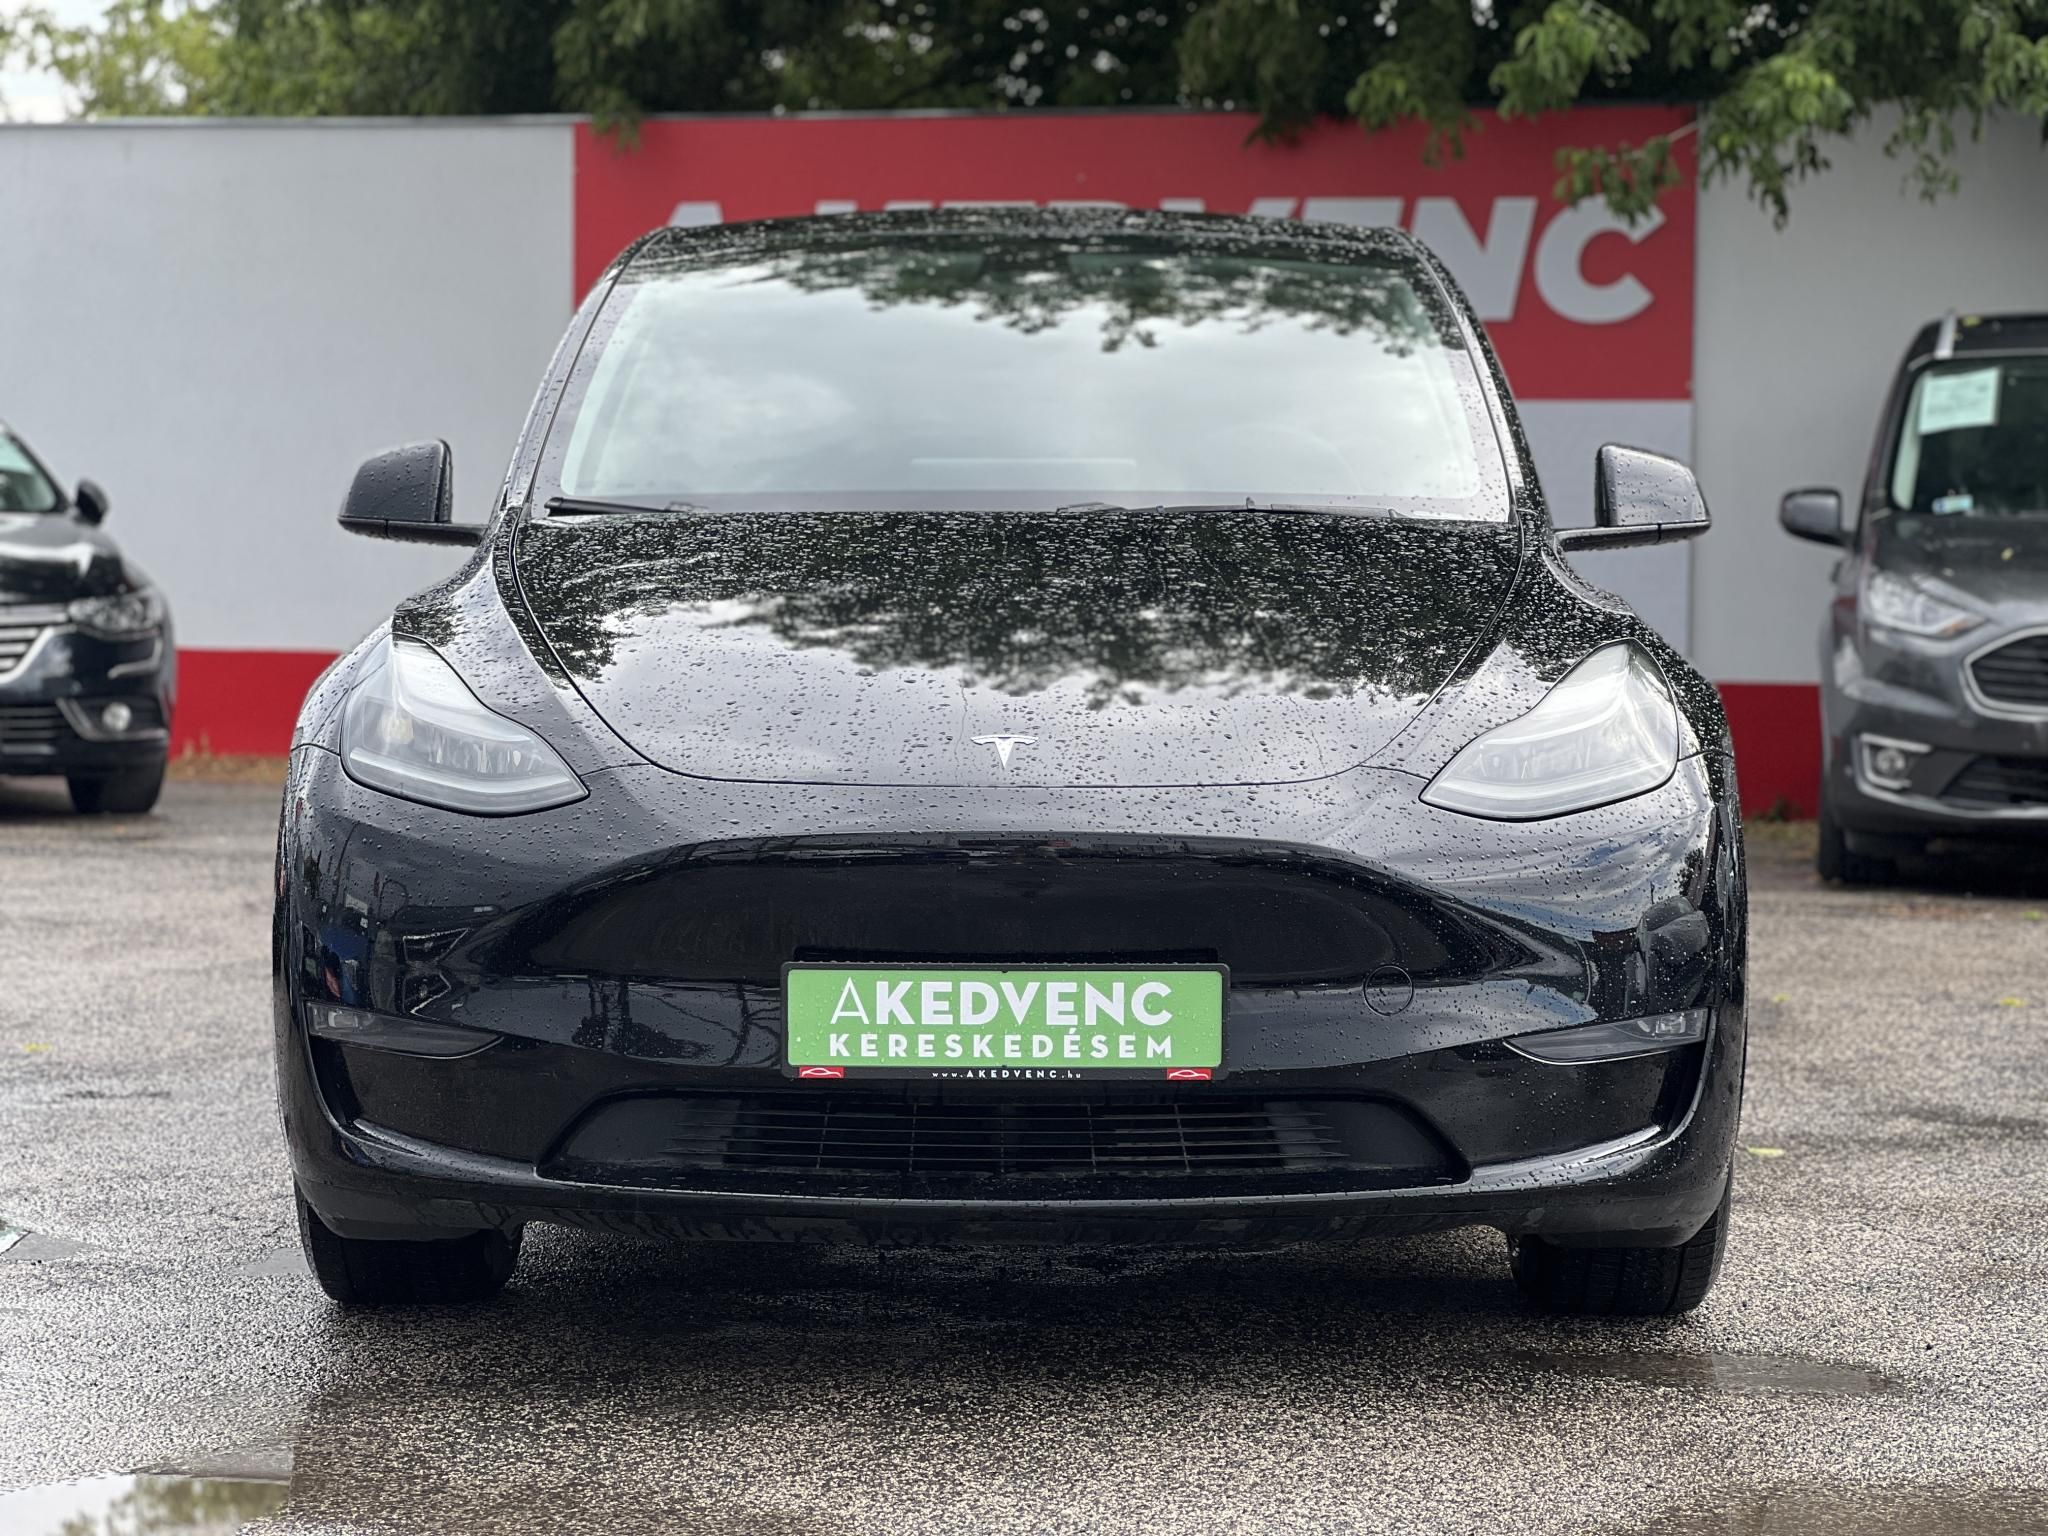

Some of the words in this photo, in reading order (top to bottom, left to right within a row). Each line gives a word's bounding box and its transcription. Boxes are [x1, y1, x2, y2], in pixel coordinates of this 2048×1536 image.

[830, 977, 1173, 1026] AKEDVENC
[829, 1028, 1173, 1058] KERESKEDÉSEM
[932, 1069, 1082, 1079] www.AKEDVENC.hu
